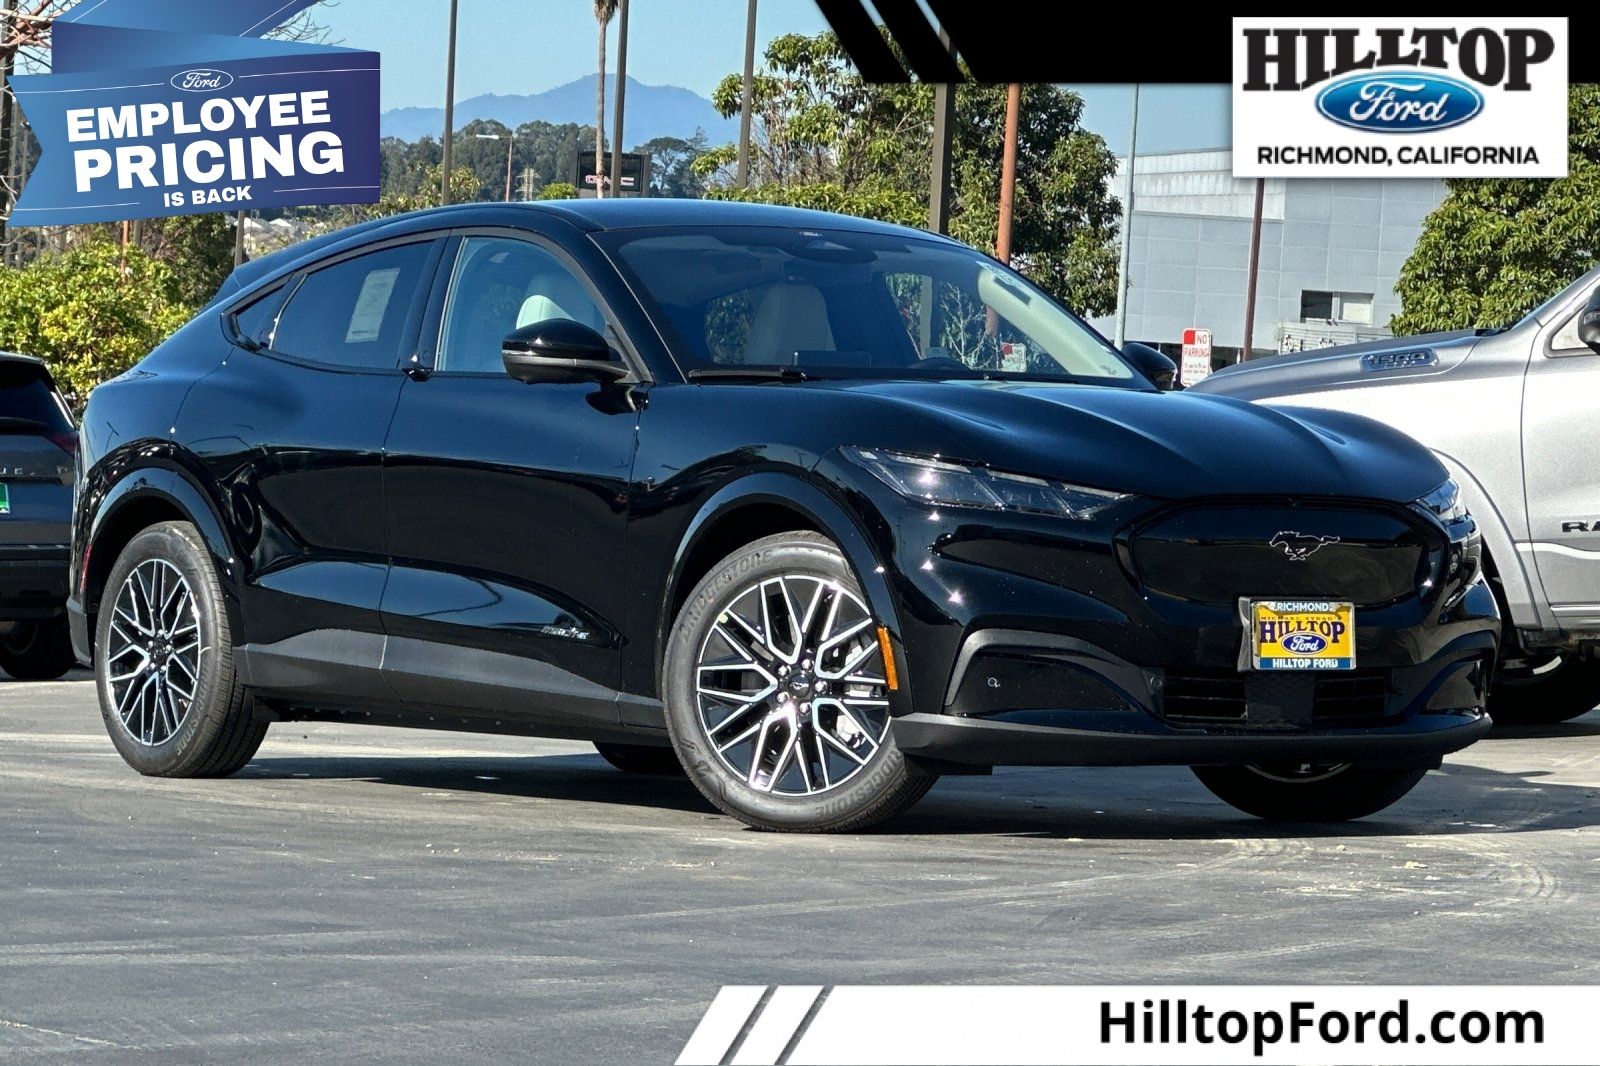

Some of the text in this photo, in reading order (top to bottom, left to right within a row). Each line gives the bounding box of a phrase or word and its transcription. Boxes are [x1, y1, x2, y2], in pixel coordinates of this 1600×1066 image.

[1197, 333, 1208, 345] NO
[1277, 602, 1329, 612] RICHMOND
[1259, 621, 1345, 643] HILLTOP
[1290, 635, 1319, 651] Ford
[1272, 658, 1339, 669] HILLTOP FORD
